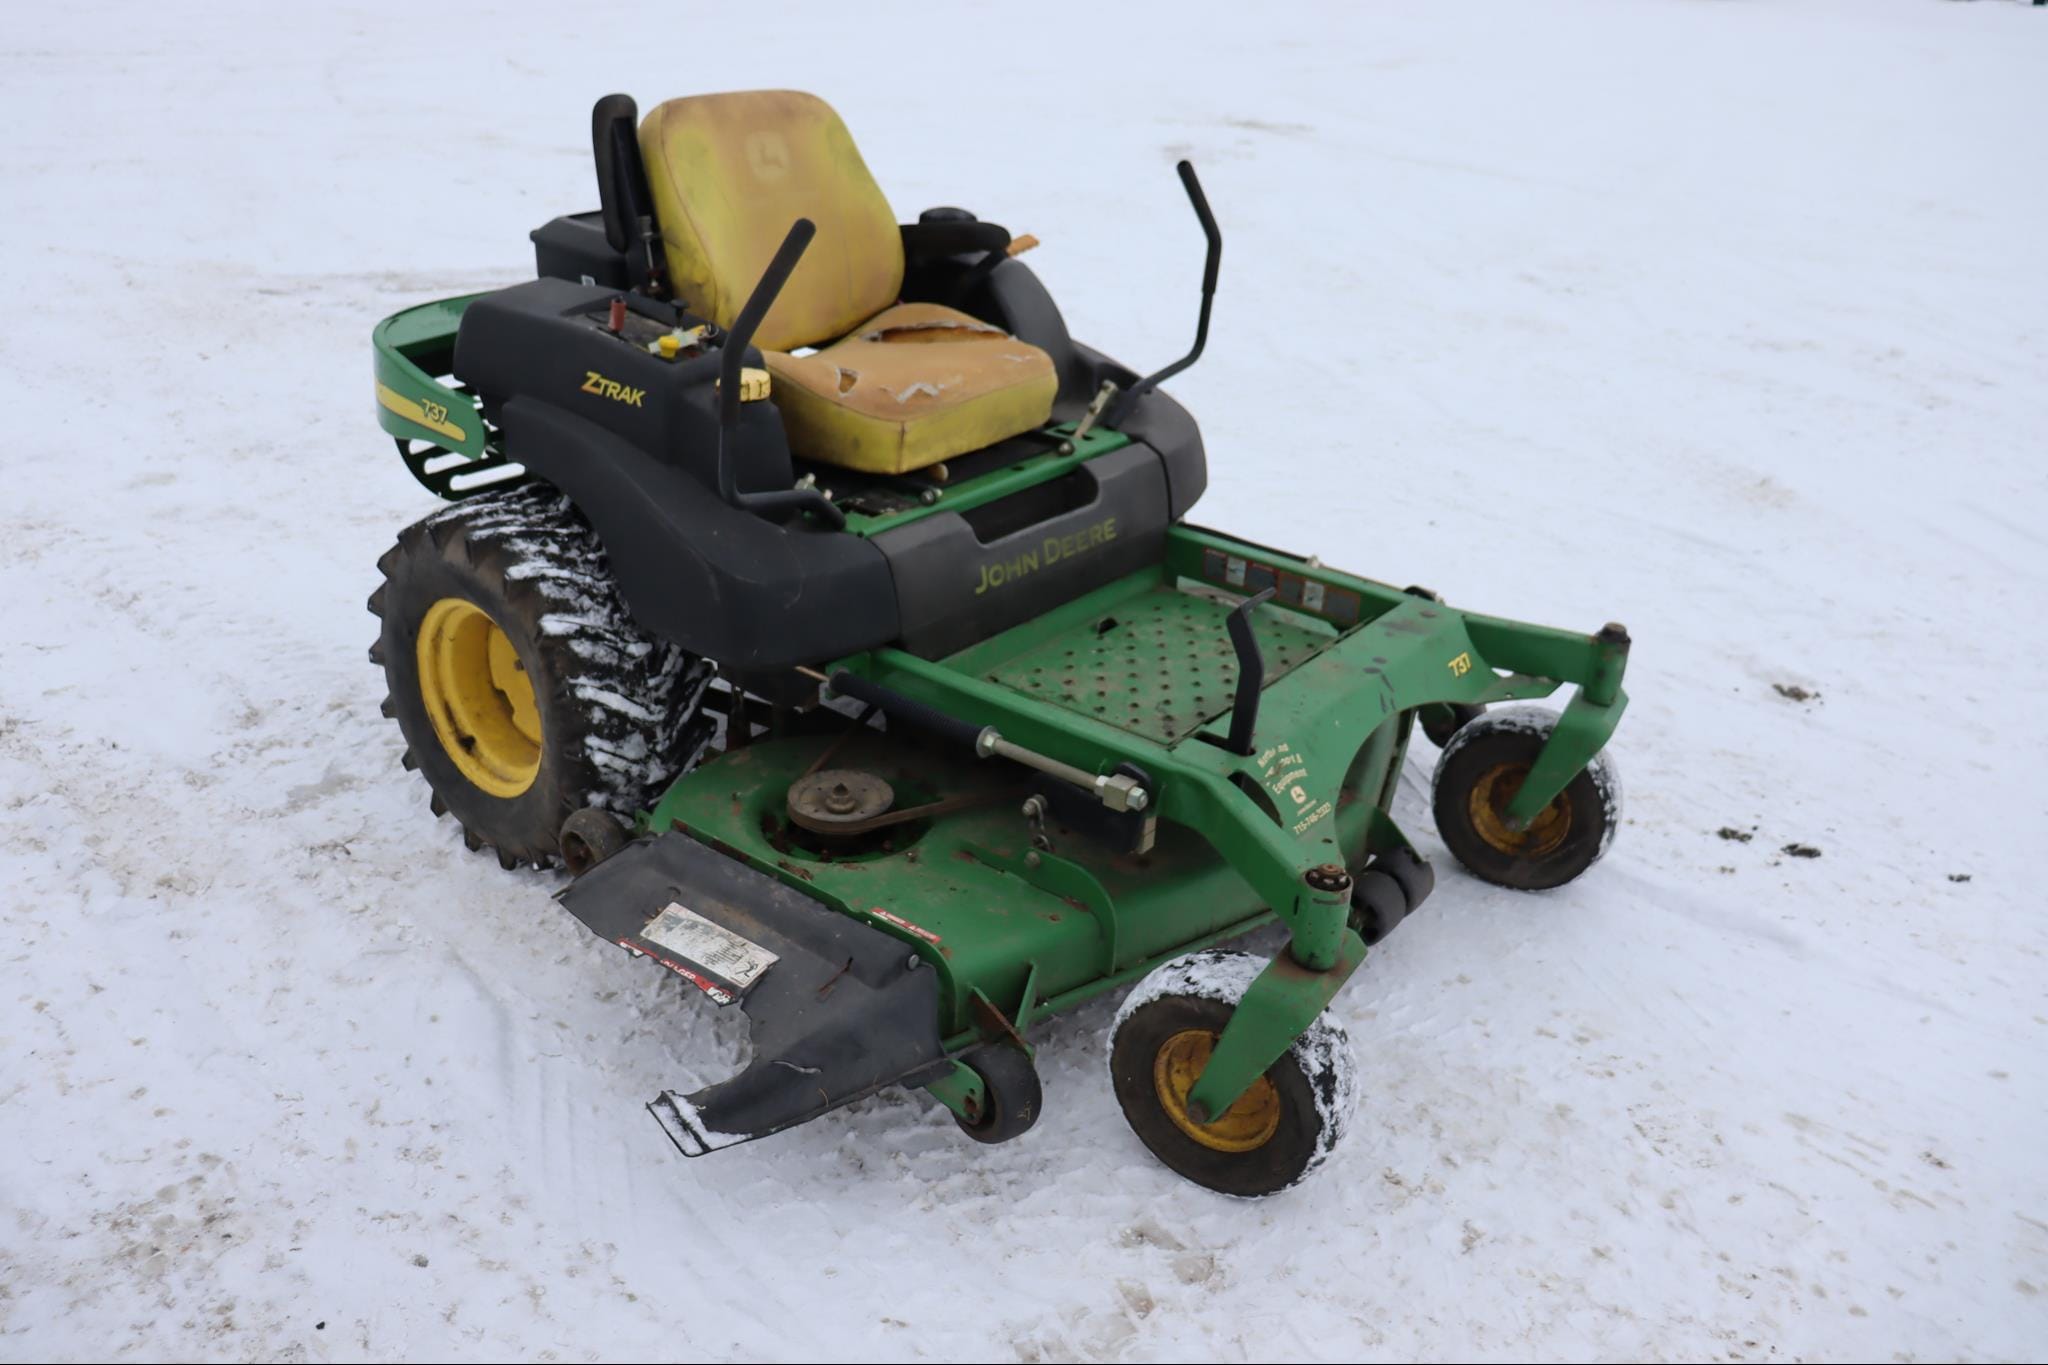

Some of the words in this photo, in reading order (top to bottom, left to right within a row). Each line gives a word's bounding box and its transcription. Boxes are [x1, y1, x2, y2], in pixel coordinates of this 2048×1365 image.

[581, 371, 646, 408] ZTRAK
[421, 398, 448, 425] 737
[975, 547, 1039, 595] JOHN
[1043, 517, 1118, 566] DEERE
[1447, 651, 1472, 678] 737
